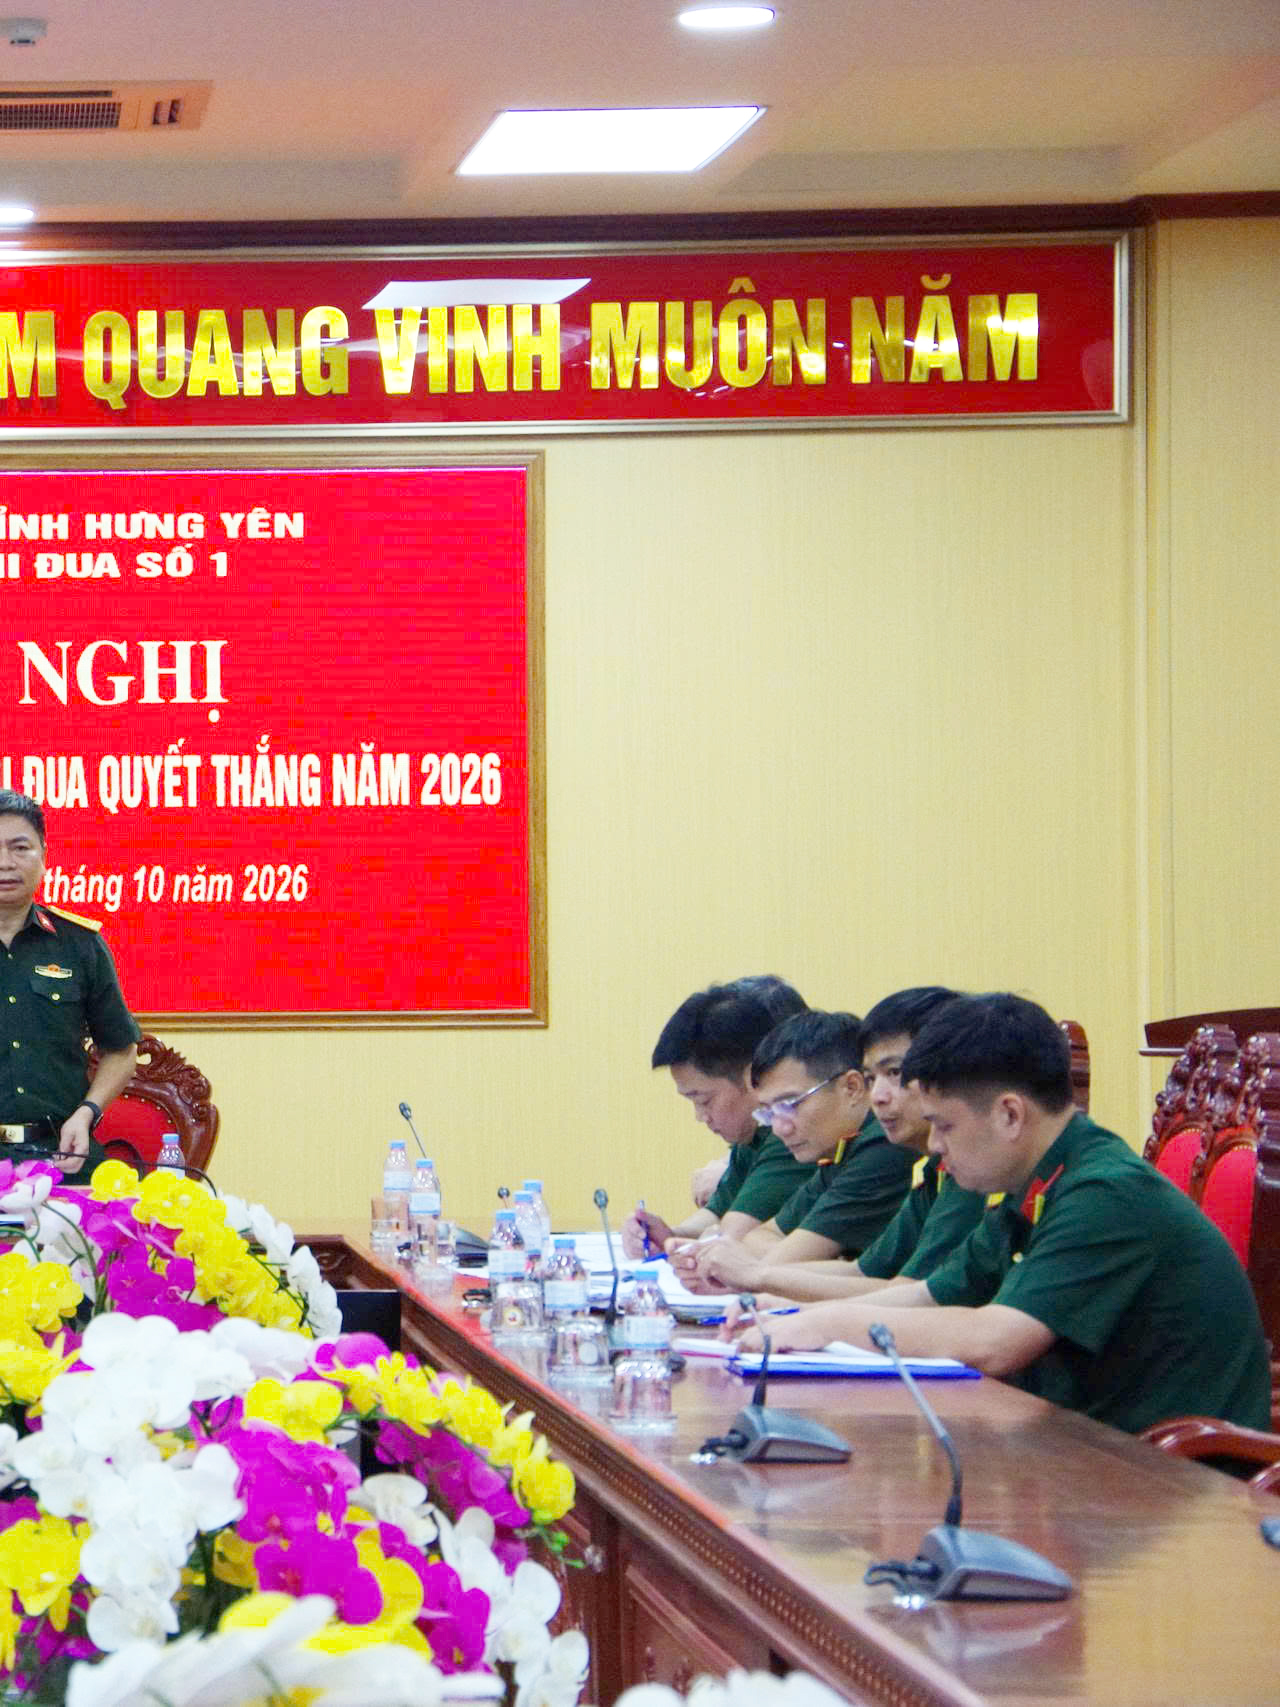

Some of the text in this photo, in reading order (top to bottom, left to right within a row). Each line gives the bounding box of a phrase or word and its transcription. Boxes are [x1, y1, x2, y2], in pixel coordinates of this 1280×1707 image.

[83, 306, 349, 410] QUANG
[374, 303, 561, 394] VINH
[590, 277, 827, 390] MUÔN
[851, 274, 1038, 384] NĂM
[85, 511, 205, 540] HƯNG
[220, 507, 305, 539] YÊN
[34, 552, 121, 579] ĐUA
[136, 543, 194, 578] SỐ
[210, 552, 228, 577] 1
[17, 640, 230, 724] NGHỊ
[23, 756, 89, 808] ĐUA
[99, 738, 202, 814] QUYẾT
[211, 735, 321, 807] THẮNG
[332, 741, 410, 806] NĂM
[421, 753, 502, 806] 2026
[43, 865, 123, 912] tháng
[133, 866, 165, 902] 10
[173, 864, 234, 902] năm
[242, 864, 309, 902] 2026
